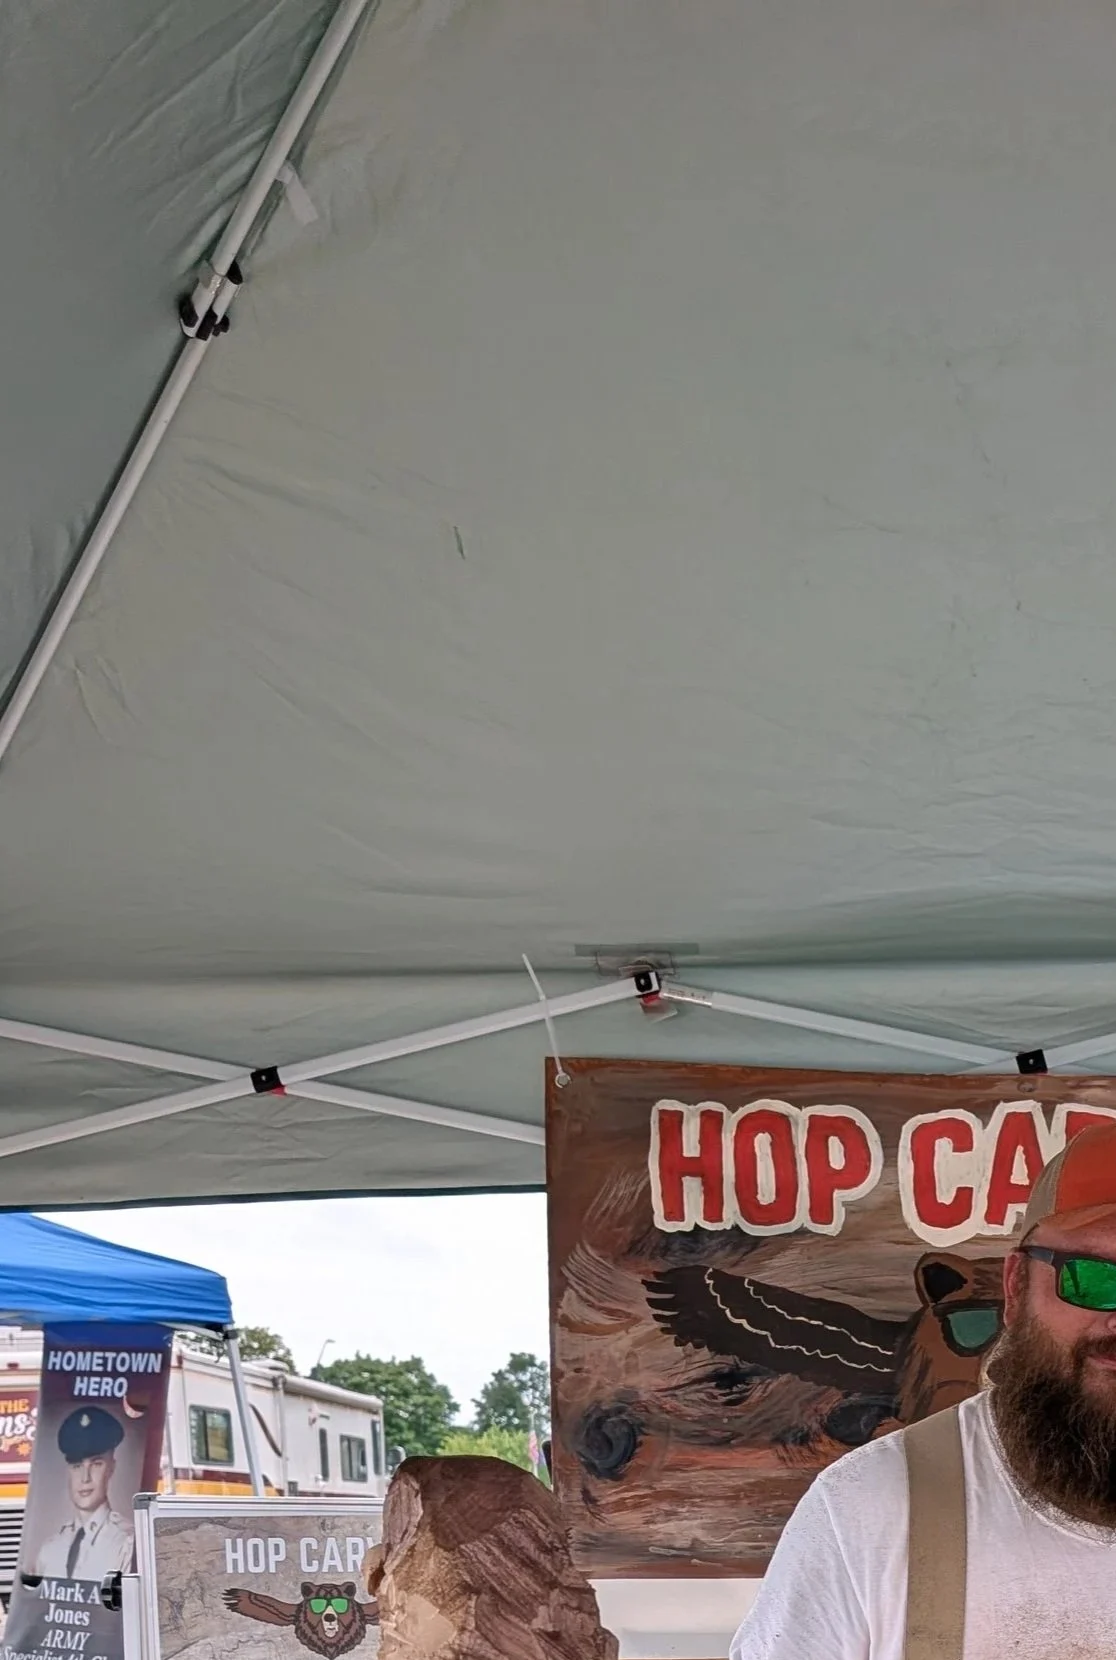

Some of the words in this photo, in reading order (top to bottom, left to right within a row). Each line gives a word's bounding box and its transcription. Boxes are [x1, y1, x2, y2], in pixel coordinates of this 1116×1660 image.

[650, 1100, 883, 1235] HOP
[48, 1351, 162, 1373] HOMETOWN
[73, 1376, 128, 1398] HERO
[225, 1537, 286, 1574] HOP
[300, 1537, 375, 1573] CAR
[40, 1579, 84, 1603] Mark
[87, 1584, 101, 1605] A
[44, 1602, 90, 1626] Jones
[40, 1629, 92, 1651] ARMY
